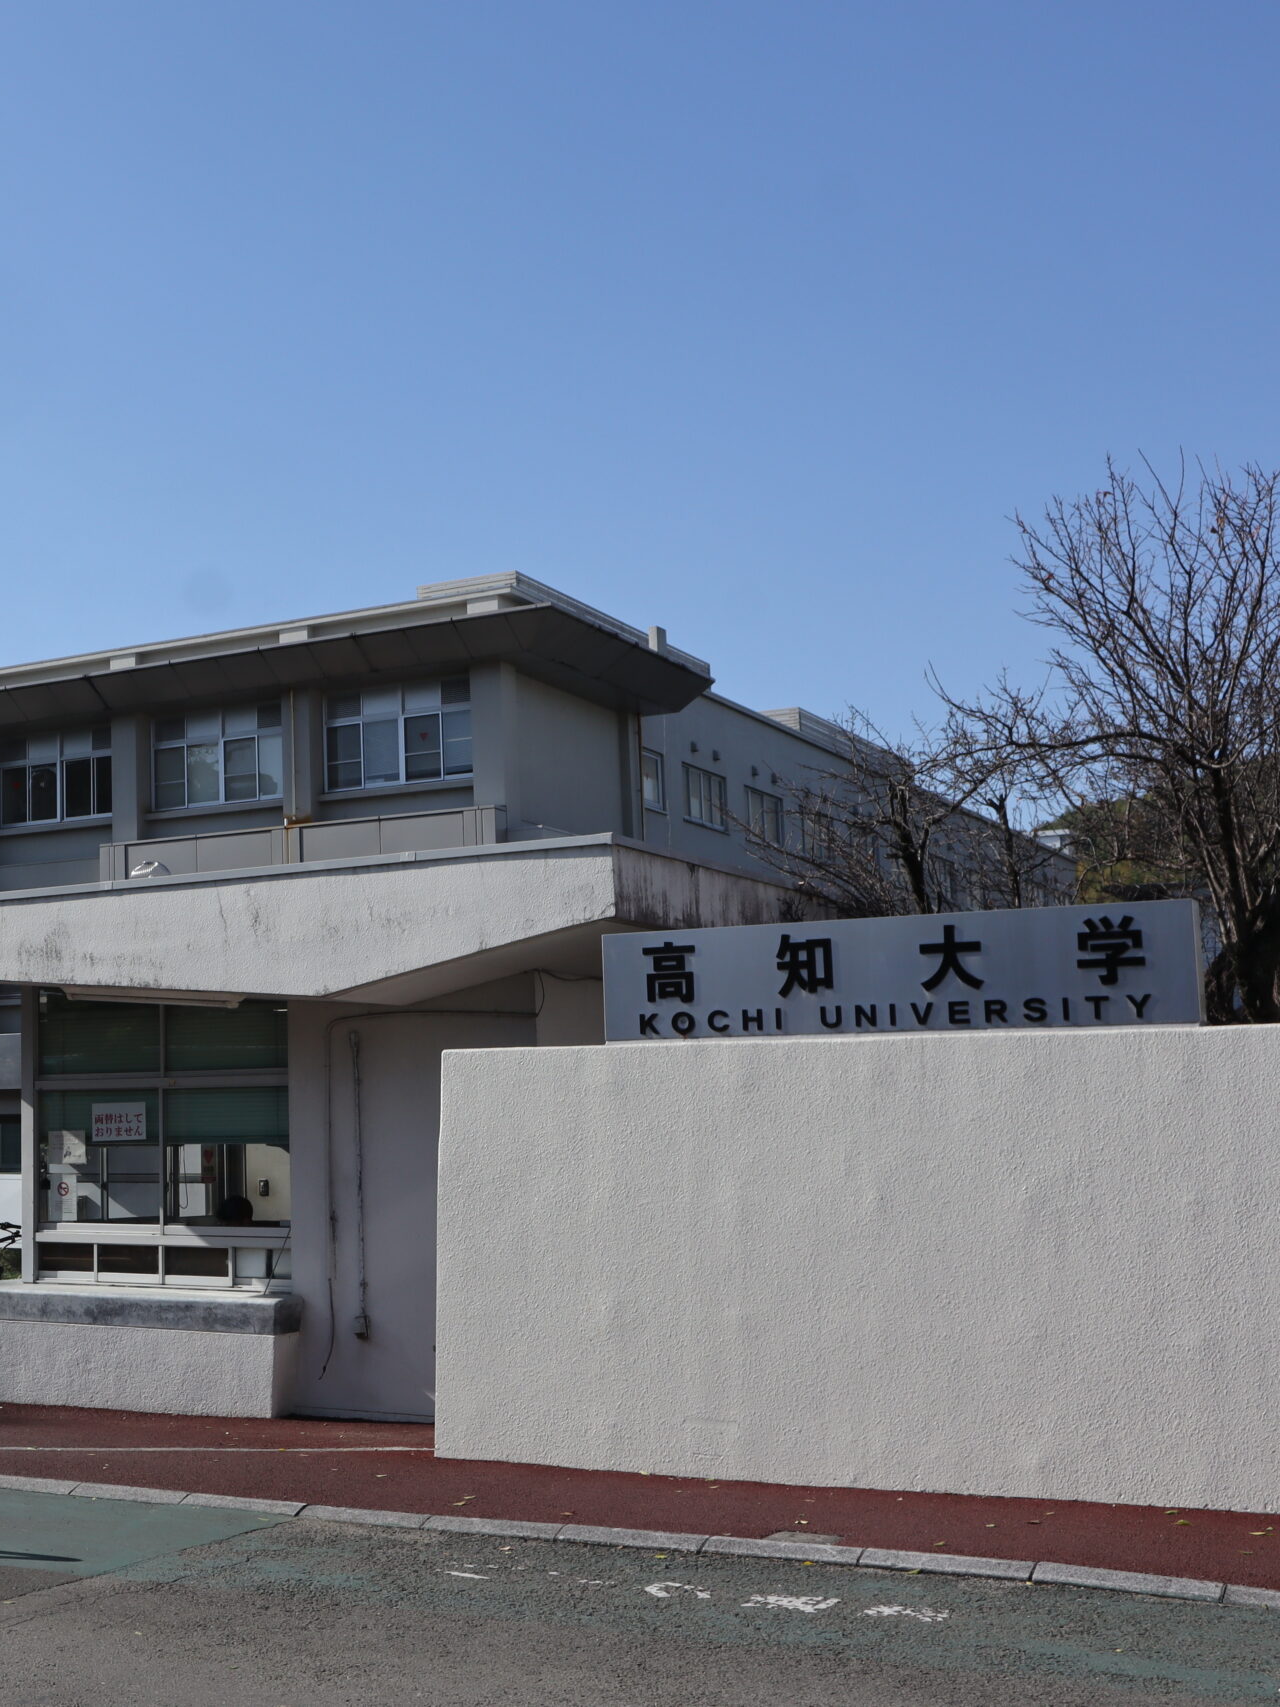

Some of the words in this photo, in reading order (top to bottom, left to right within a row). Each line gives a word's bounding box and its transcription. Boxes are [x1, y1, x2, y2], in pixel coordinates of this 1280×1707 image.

[641, 915, 1147, 1004] 高知大学
[639, 1006, 784, 1037] KOCHI
[819, 993, 1152, 1030] UNIVERSITY
[94, 1112, 143, 1125] 両替はして
[94, 1125, 143, 1137] おりません
